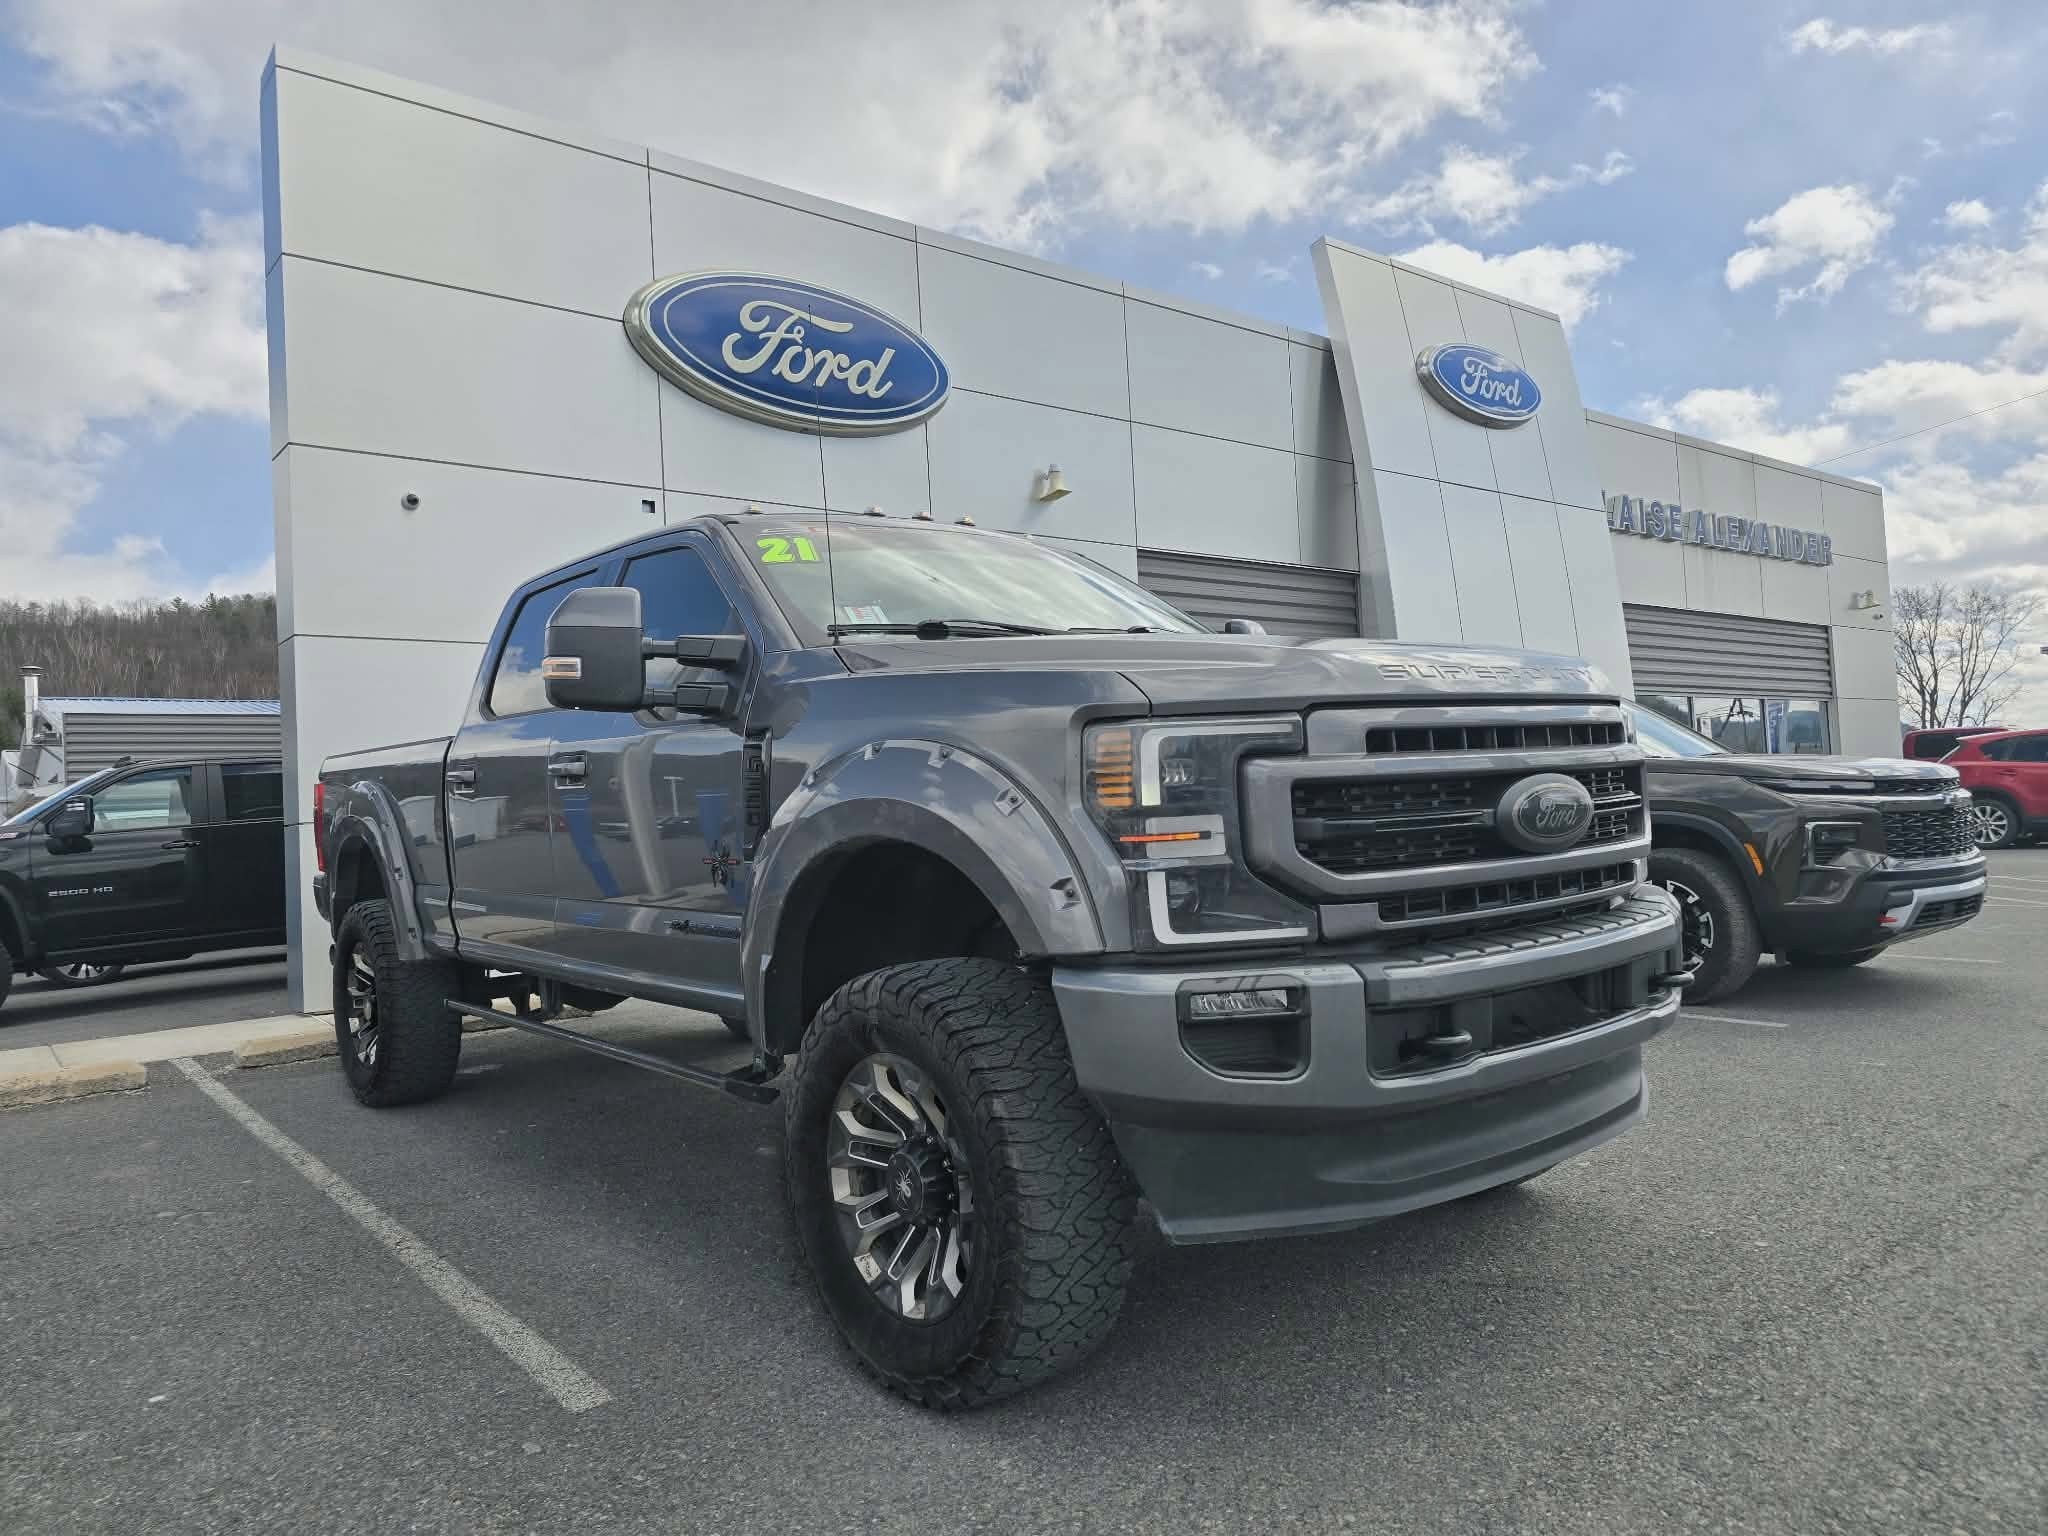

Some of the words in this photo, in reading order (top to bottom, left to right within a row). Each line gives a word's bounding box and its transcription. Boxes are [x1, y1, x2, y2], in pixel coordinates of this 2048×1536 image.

[722, 300, 896, 399] Ford
[1461, 356, 1522, 406] Ford
[757, 537, 819, 564] 21
[1682, 510, 1833, 566] ALEXANDER
[1376, 663, 1519, 682] SUPER
[1535, 797, 1578, 828] Ford
